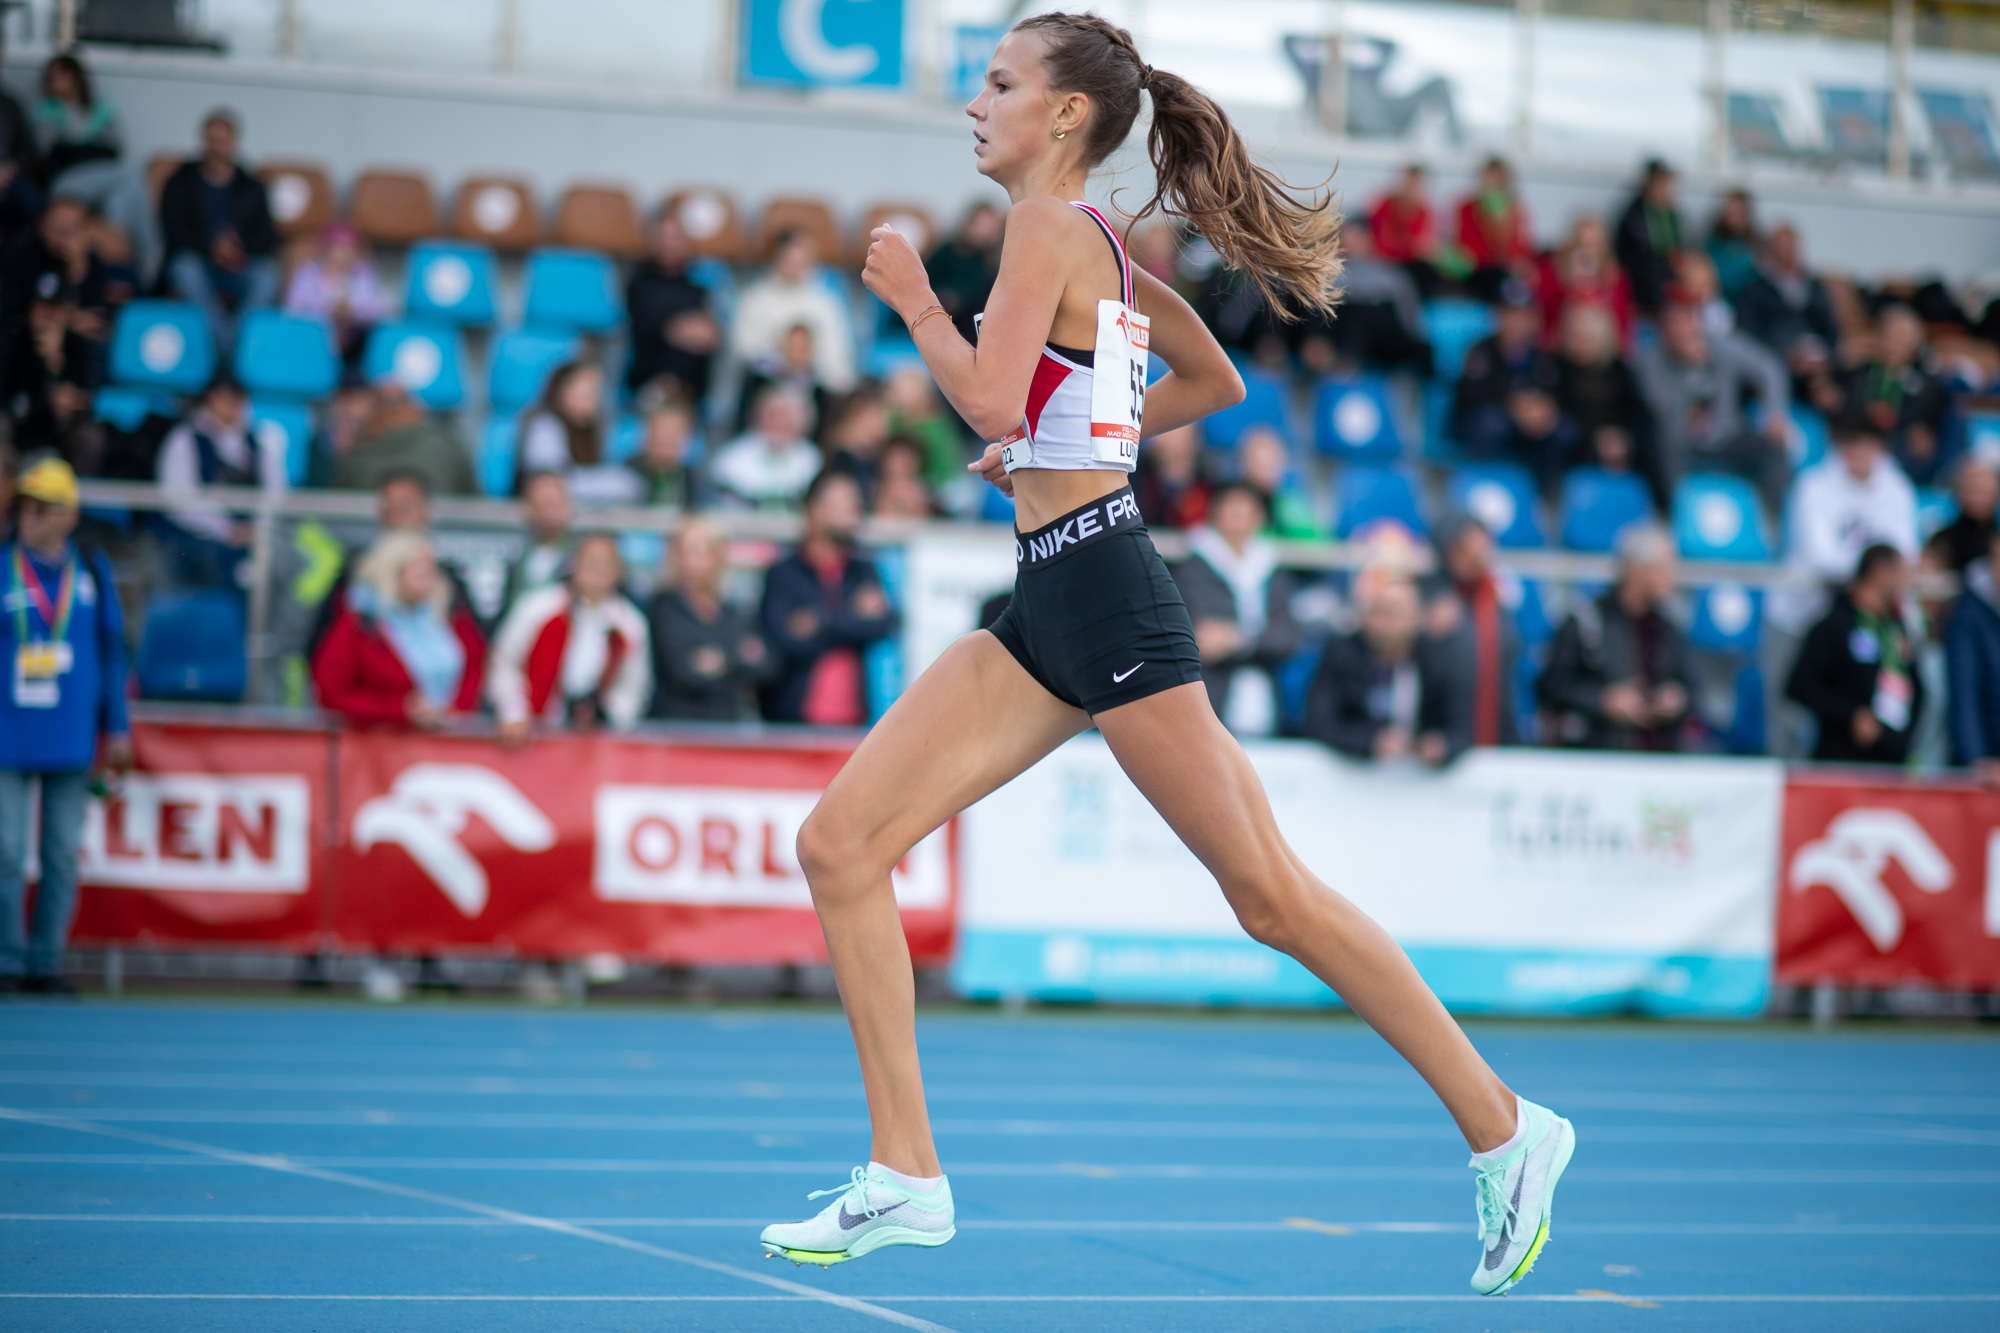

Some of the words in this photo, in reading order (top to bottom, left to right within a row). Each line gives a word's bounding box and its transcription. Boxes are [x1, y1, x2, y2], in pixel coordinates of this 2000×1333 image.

[778, 0, 880, 79] C
[1029, 507, 1103, 563] NIKE
[103, 800, 276, 864] LEN
[627, 815, 798, 879] ORL
